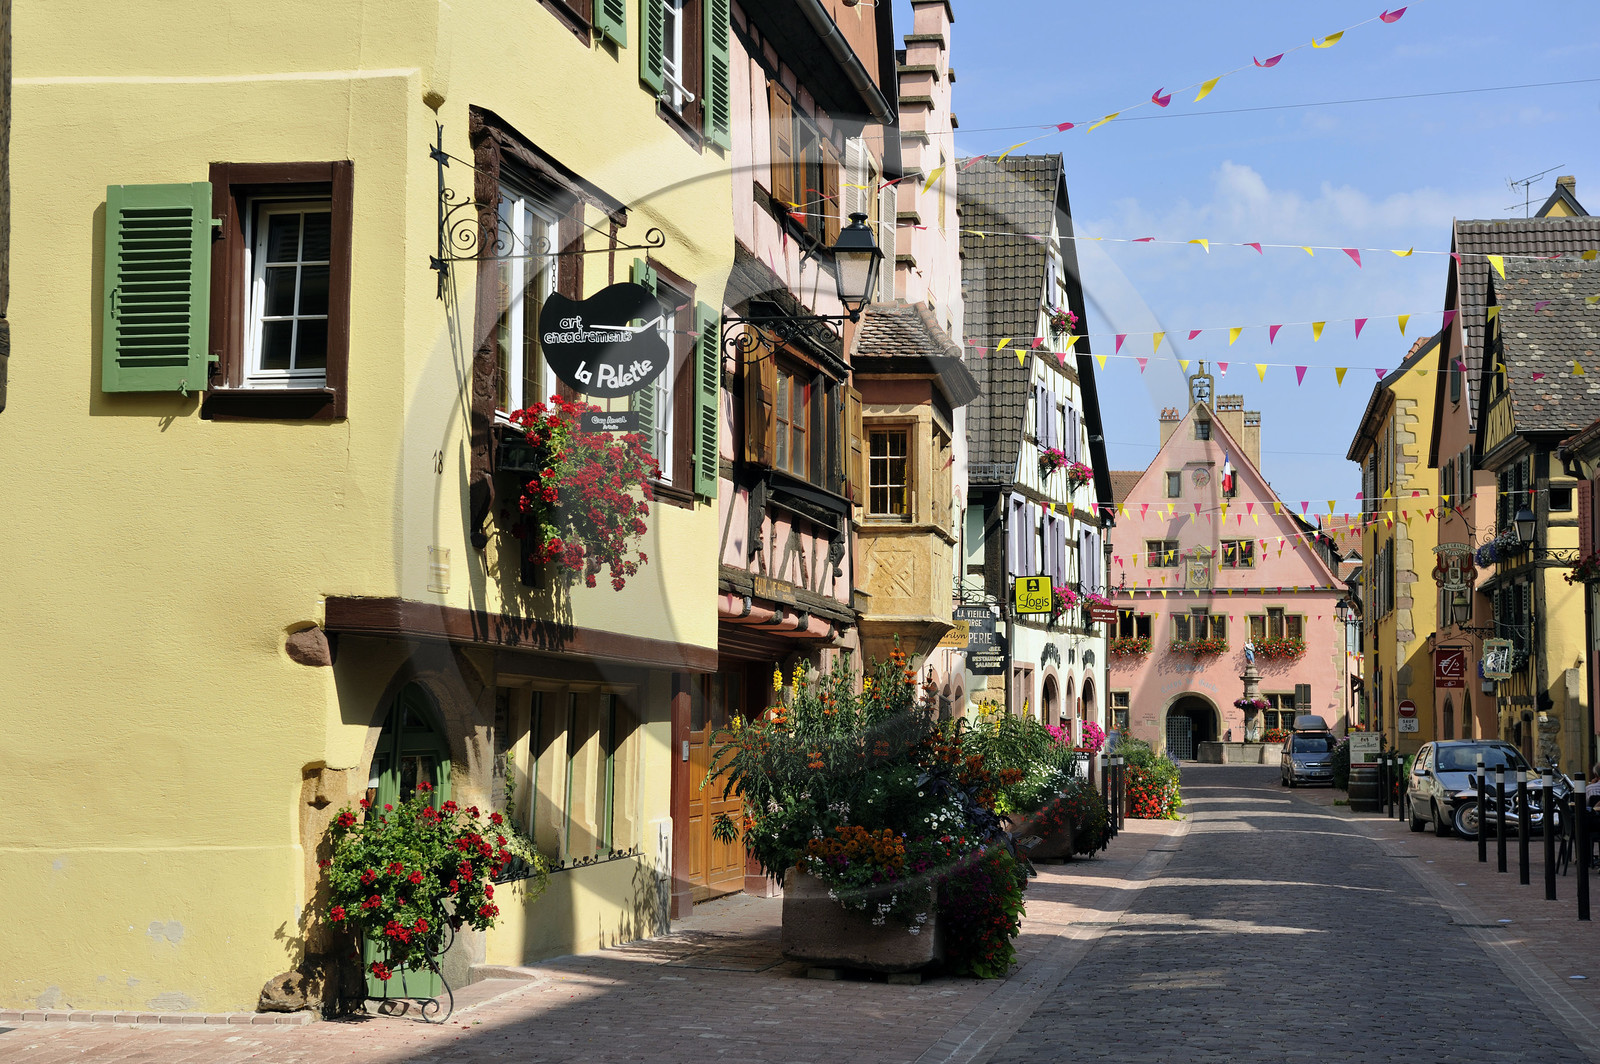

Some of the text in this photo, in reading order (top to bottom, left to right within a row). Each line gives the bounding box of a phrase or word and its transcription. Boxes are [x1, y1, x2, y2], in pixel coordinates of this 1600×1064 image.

[560, 315, 583, 329] art
[544, 328, 633, 344] encadrements
[596, 359, 653, 389] Palette
[432, 449, 443, 475] 18
[1018, 592, 1049, 610] Logis
[967, 610, 990, 618] VIEILLE
[966, 619, 982, 627] ORGE
[969, 632, 992, 644] PERIE
